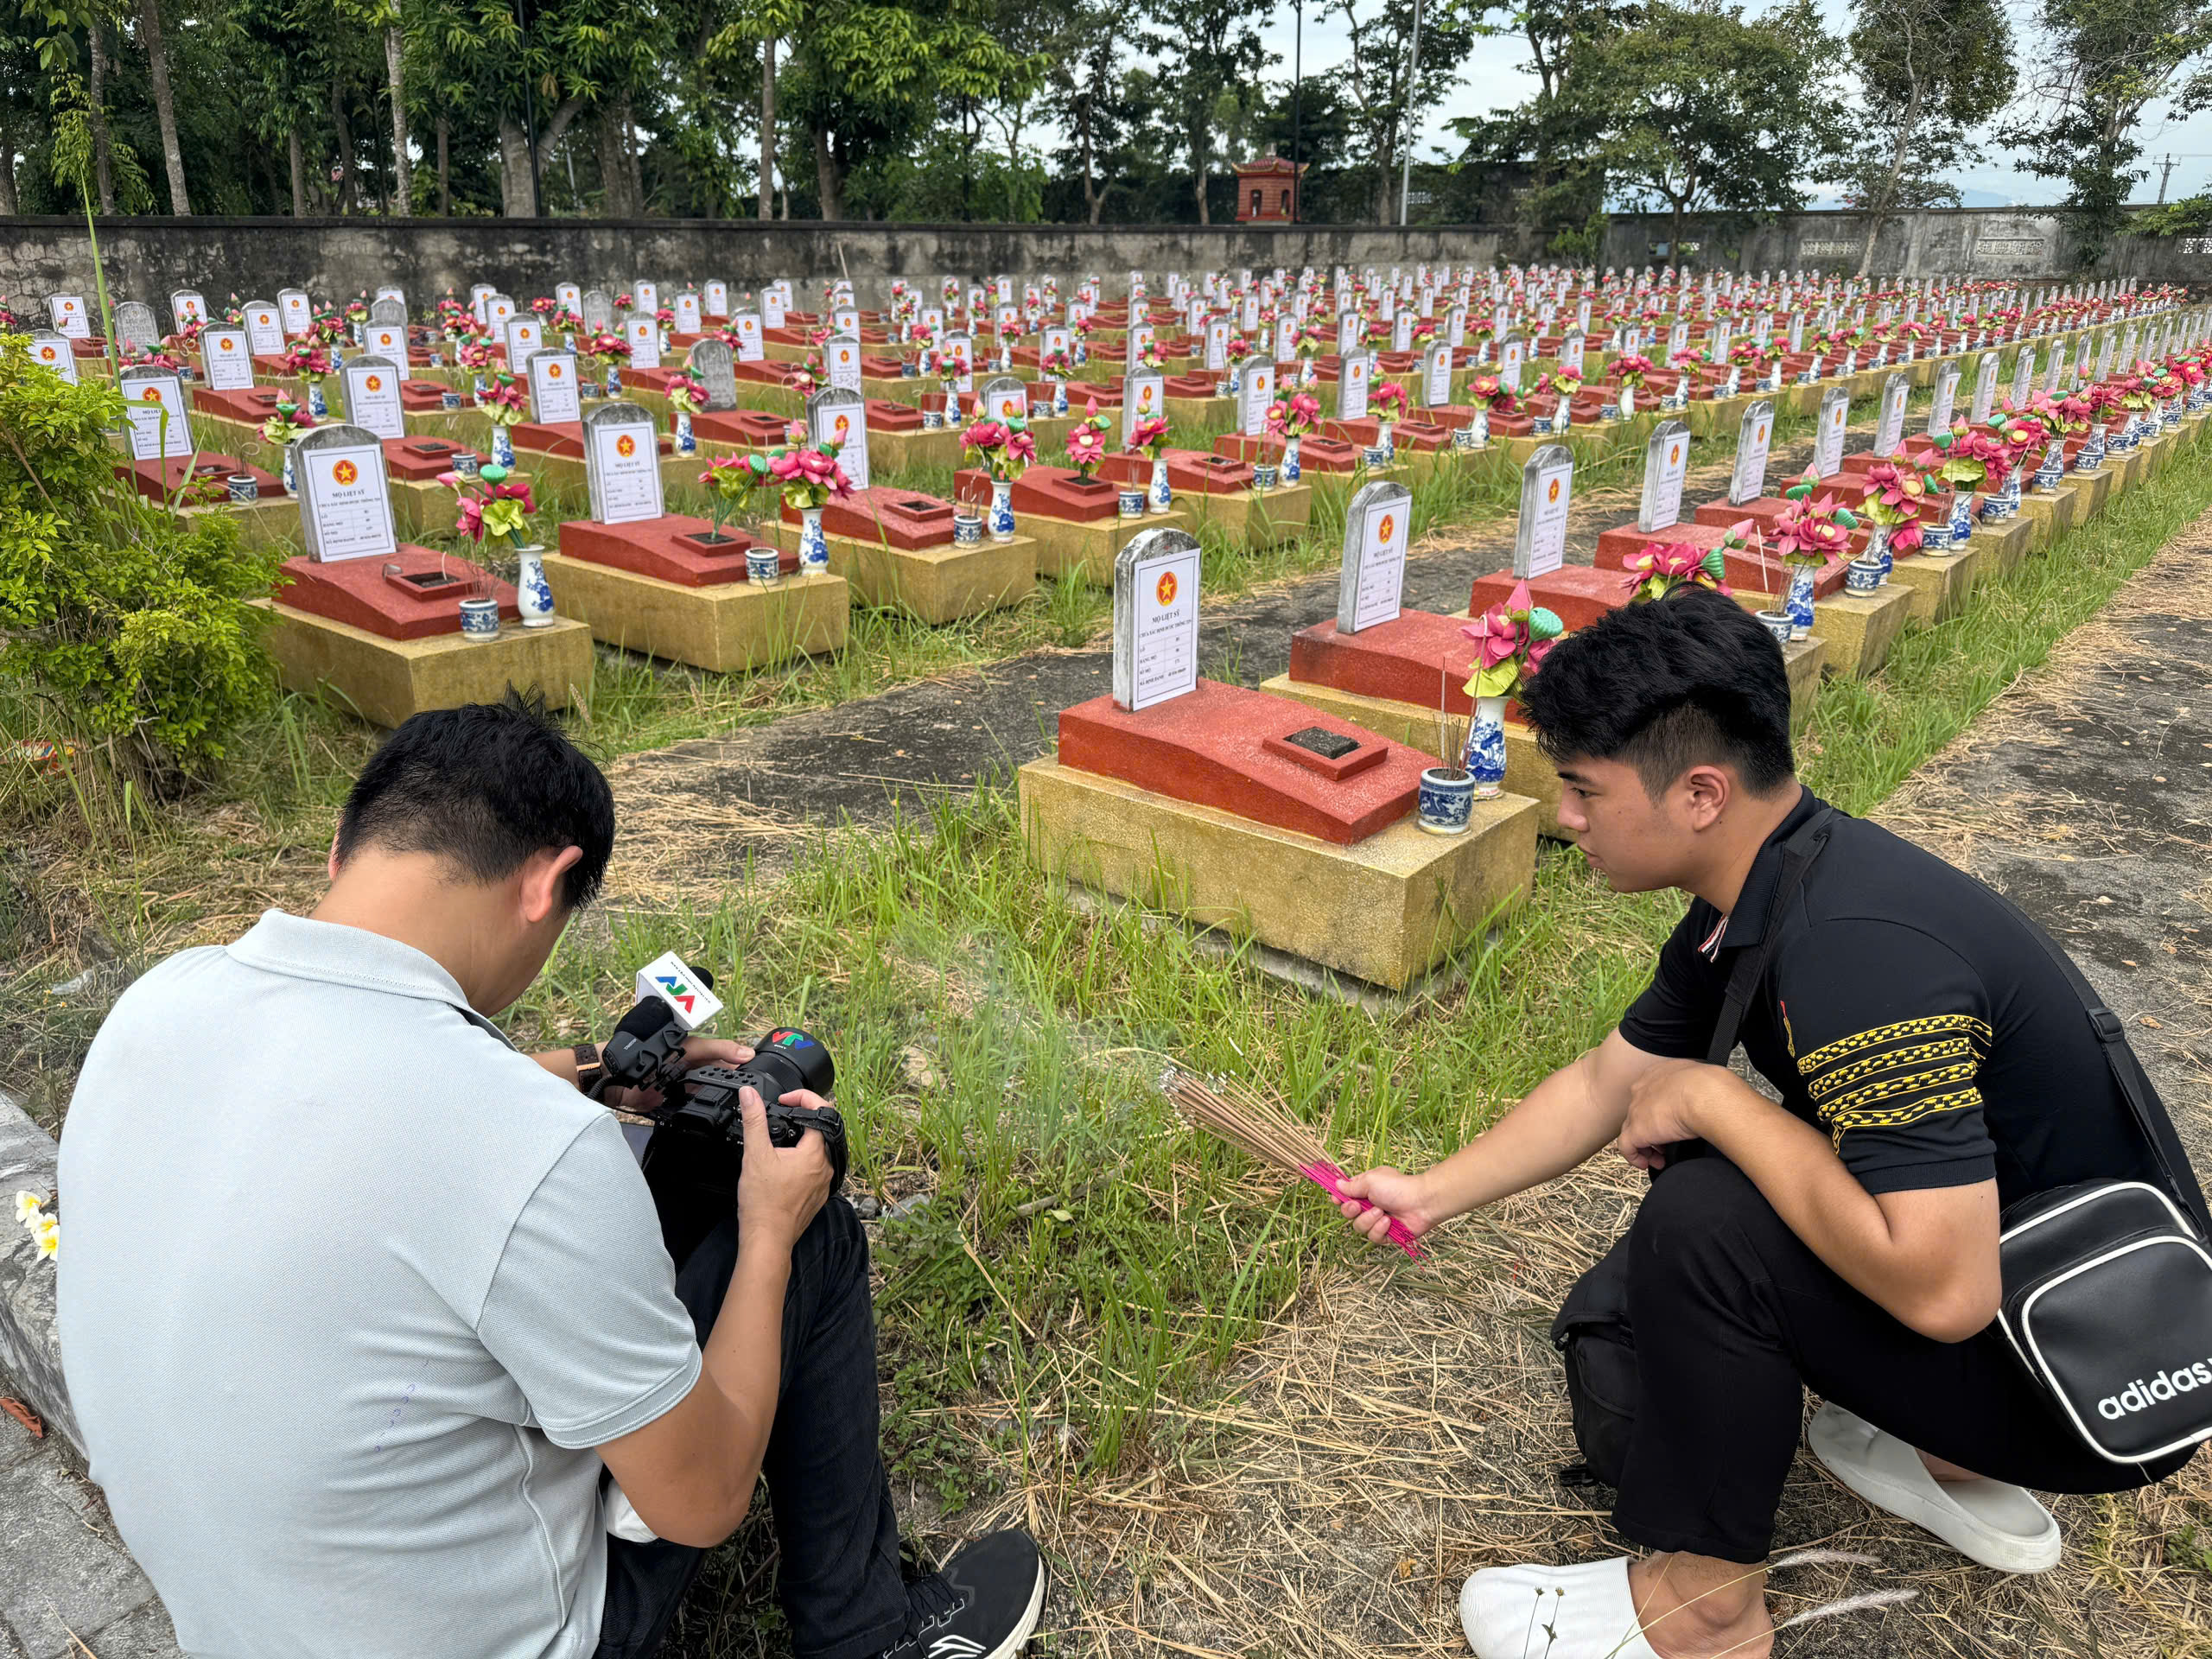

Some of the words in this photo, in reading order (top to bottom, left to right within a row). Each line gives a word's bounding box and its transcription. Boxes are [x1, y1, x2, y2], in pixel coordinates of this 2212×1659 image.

[1152, 615, 1161, 624] MỘ
[1161, 612, 1173, 621] LIỆT
[655, 976, 696, 1014] VTV
[772, 1031, 815, 1051] VTV
[2097, 1360, 2212, 1421] adidas
